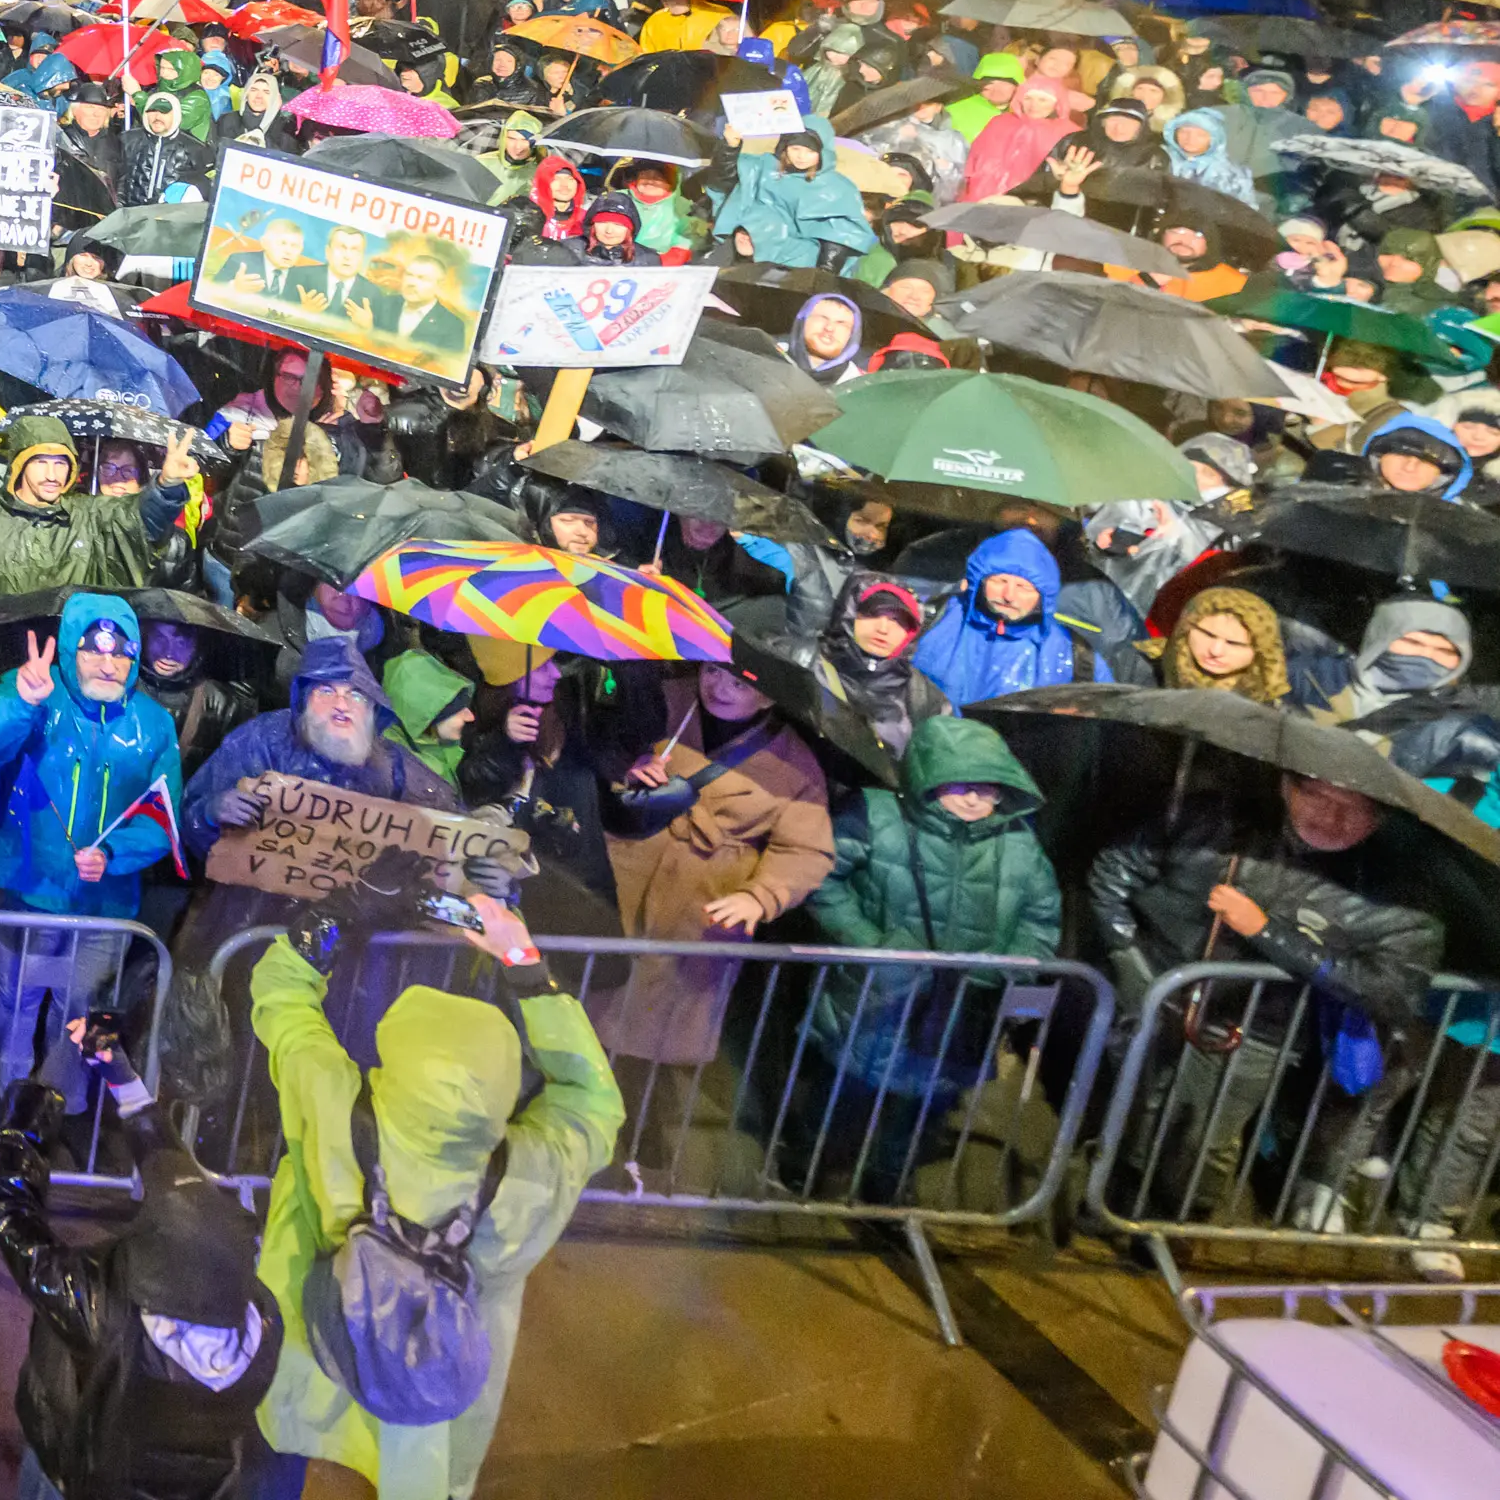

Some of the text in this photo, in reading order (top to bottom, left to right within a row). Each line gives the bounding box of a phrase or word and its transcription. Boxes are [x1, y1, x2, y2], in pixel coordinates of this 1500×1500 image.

[239, 162, 489, 249] PO NICH POTOPA!!!
[576, 278, 639, 322] 89
